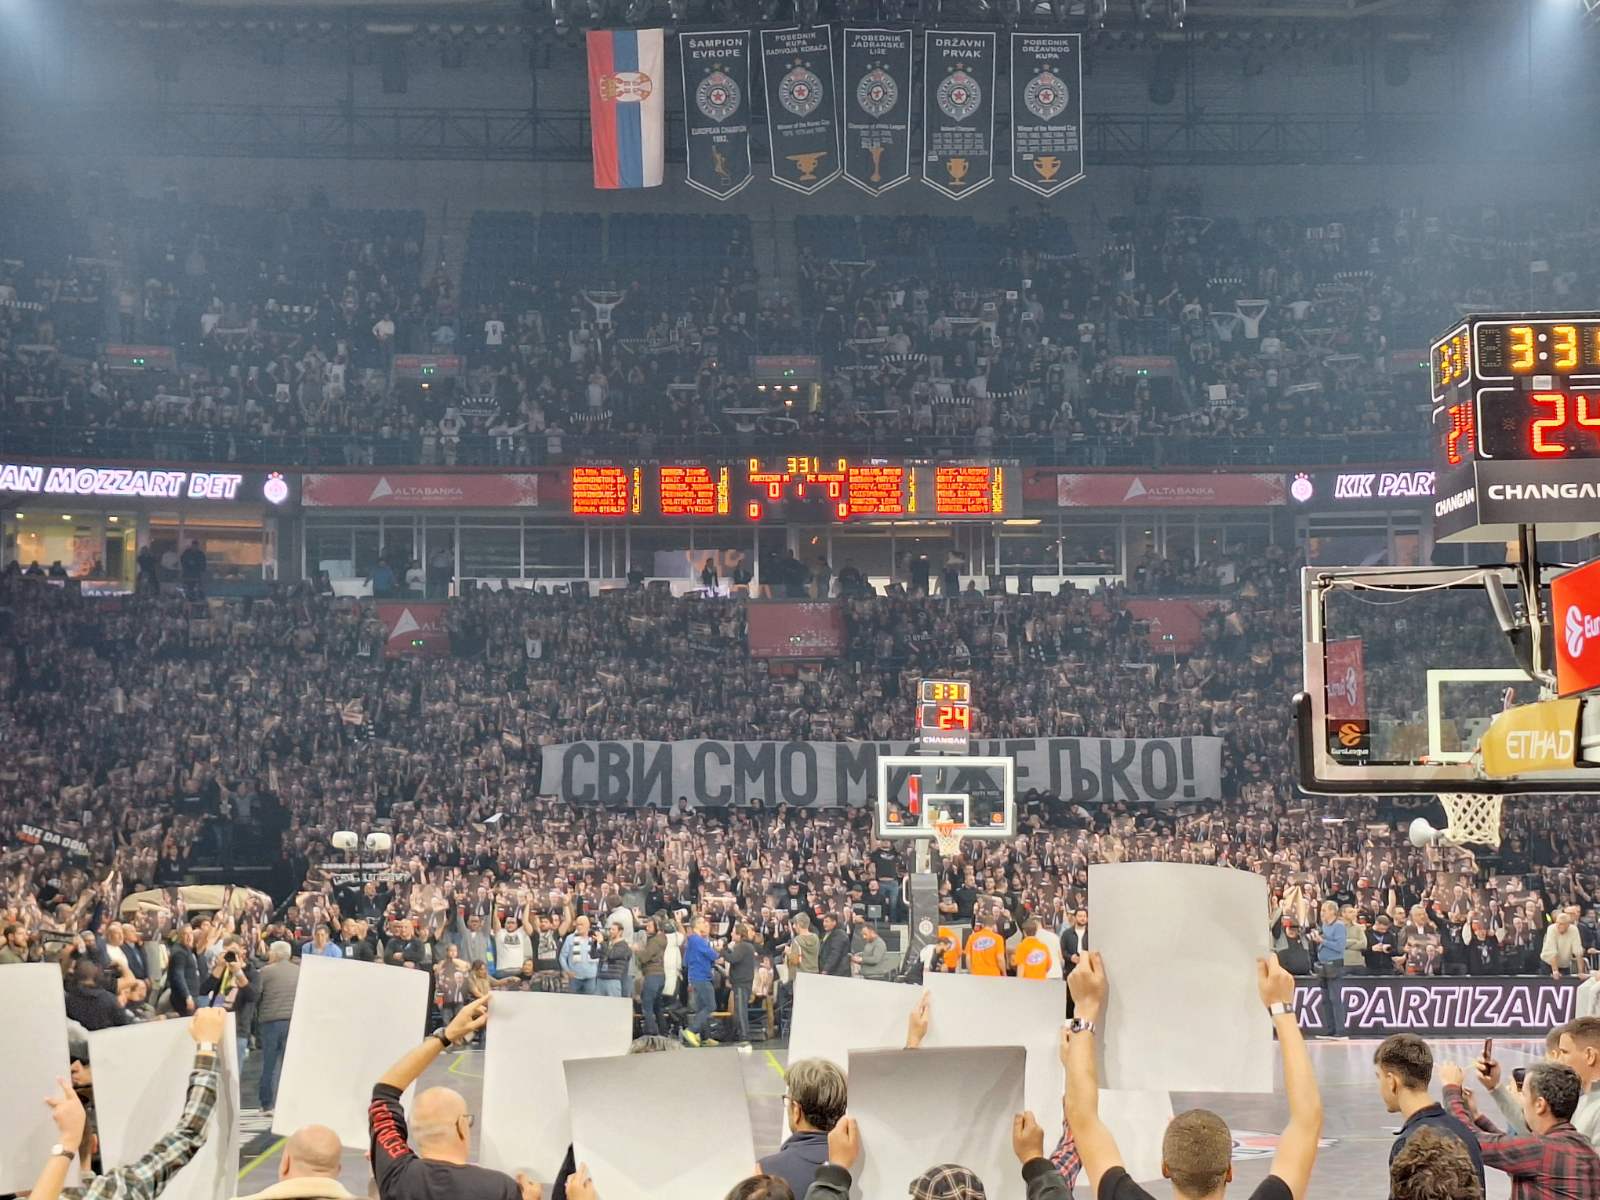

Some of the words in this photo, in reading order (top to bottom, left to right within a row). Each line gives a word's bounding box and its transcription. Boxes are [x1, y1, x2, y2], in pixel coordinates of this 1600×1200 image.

[689, 38, 743, 48] ŠAMPION
[692, 49, 741, 59] EVROPE
[935, 38, 986, 48] DRŽAVNI
[943, 49, 981, 58] PRVAK
[1508, 326, 1600, 370] 3:3
[0, 464, 43, 492] AN
[45, 467, 186, 496] MOZZART
[187, 473, 242, 499] BET
[393, 487, 464, 496] ALTABANKA
[1148, 487, 1215, 496] ALTABANKA
[1335, 473, 1376, 498] KK
[1378, 471, 1436, 497] PAR
[1487, 483, 1600, 500] CHANGA
[1435, 487, 1475, 517] CHANGAN
[939, 706, 969, 731] 24
[1505, 730, 1574, 759] ETIHAD
[561, 741, 673, 806] СВИ
[693, 741, 818, 807] СМО
[1340, 985, 1575, 1028] PARTIZAN
